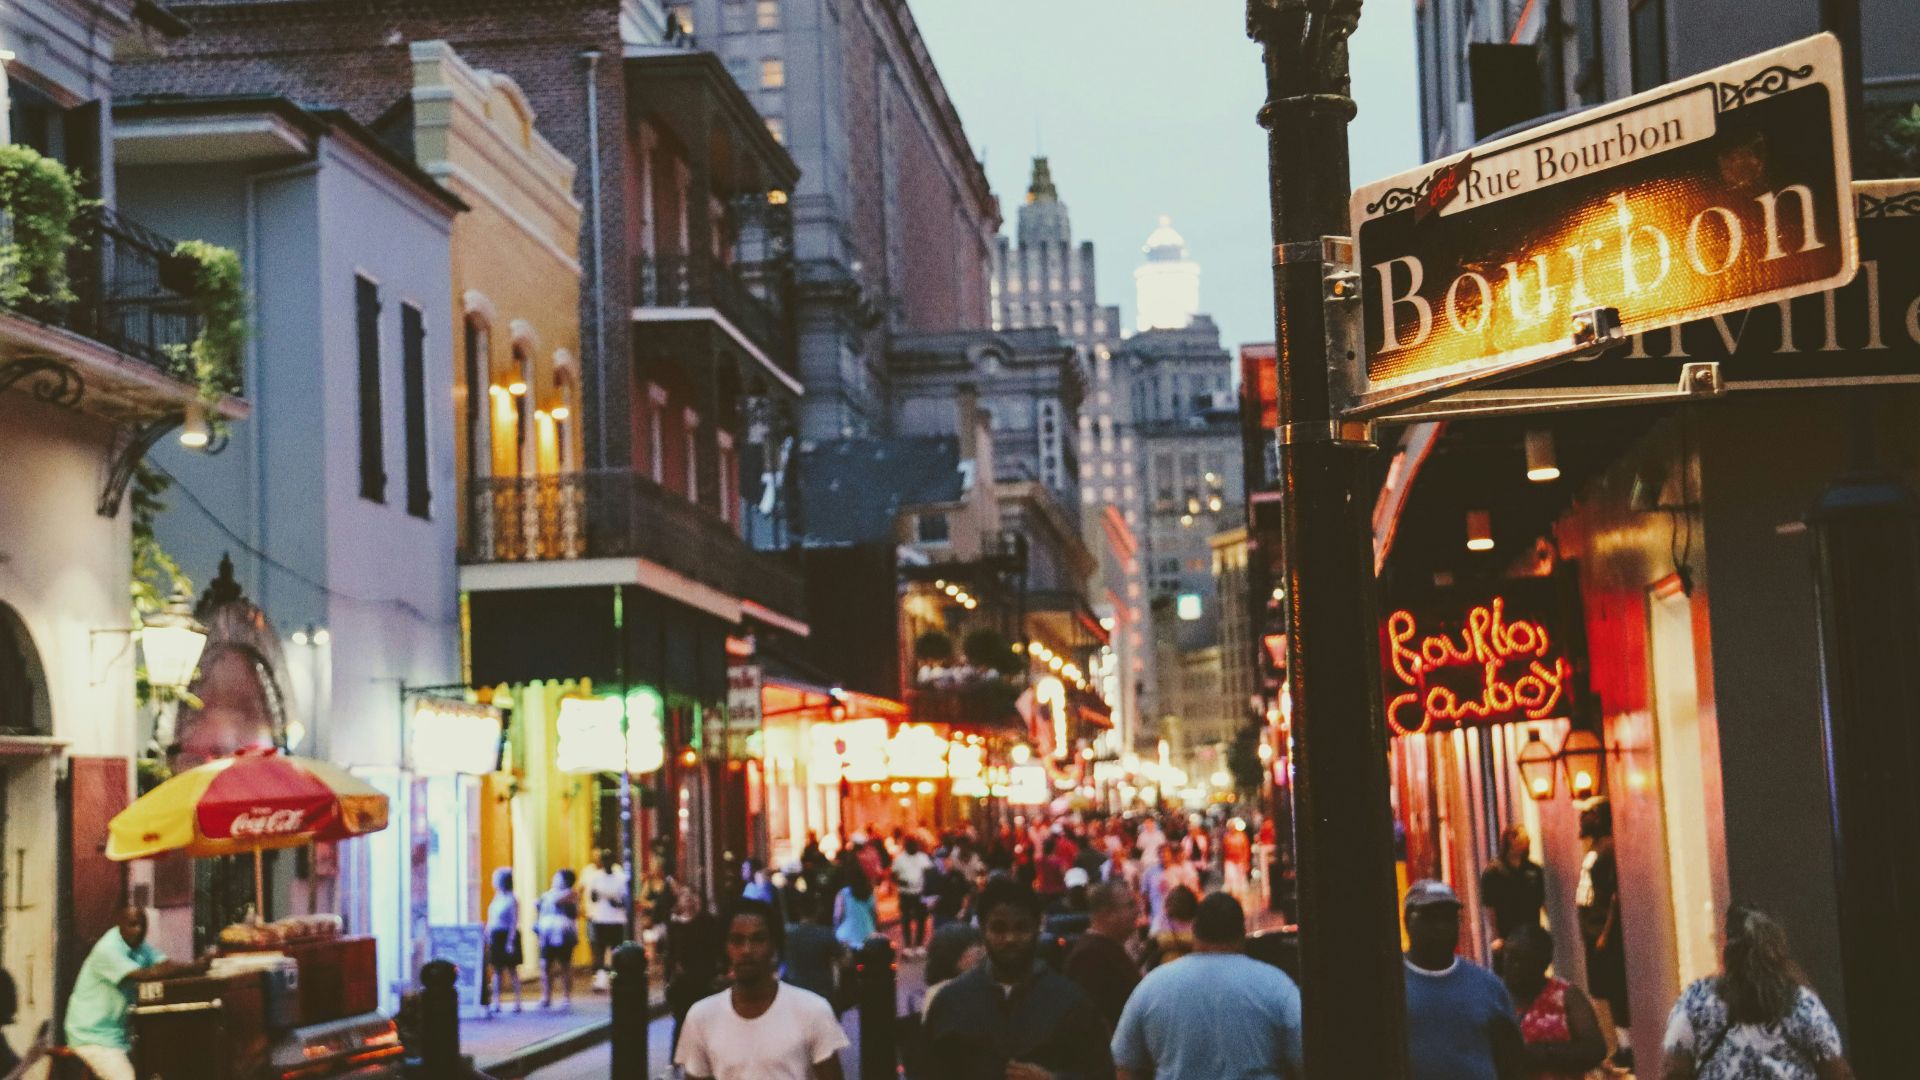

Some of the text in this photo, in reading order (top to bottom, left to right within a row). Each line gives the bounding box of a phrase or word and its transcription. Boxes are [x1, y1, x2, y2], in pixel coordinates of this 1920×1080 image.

[1464, 168, 1521, 204] Rue
[1533, 117, 1684, 182] Bourbon
[1371, 184, 1826, 355] Bourbon
